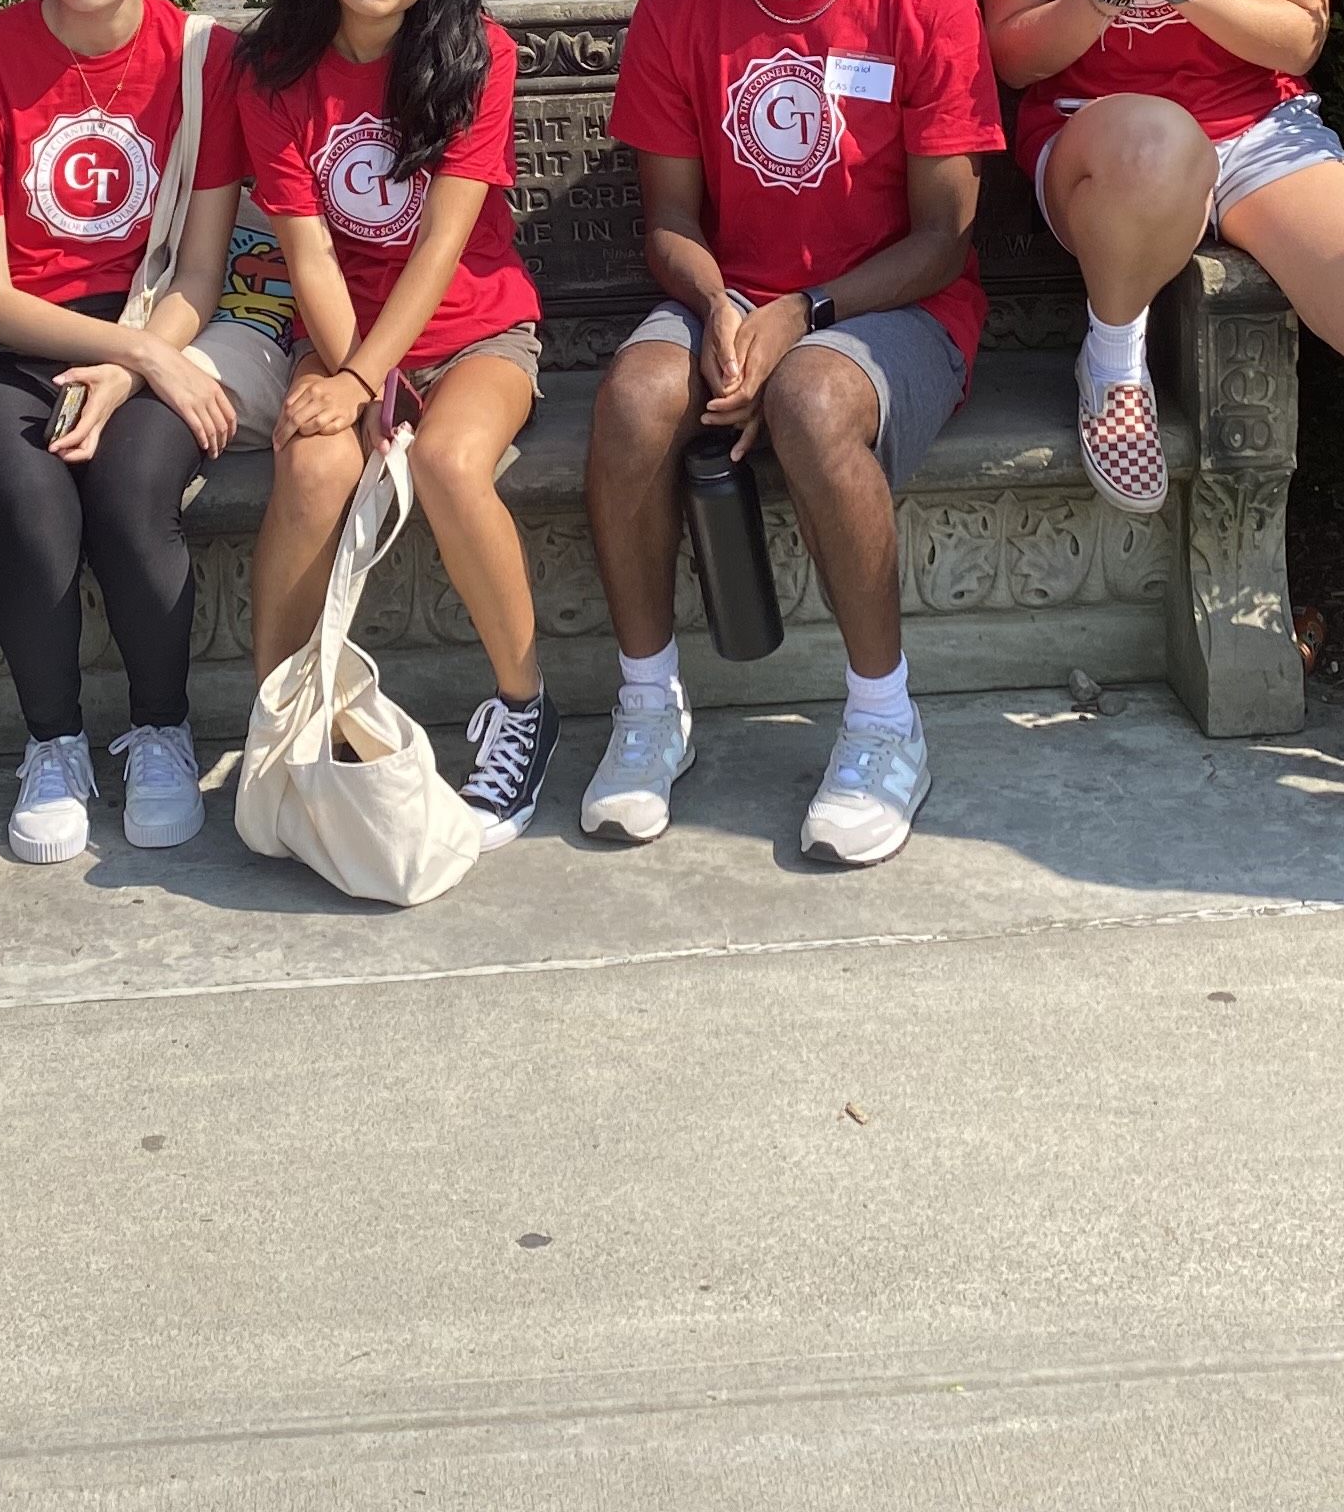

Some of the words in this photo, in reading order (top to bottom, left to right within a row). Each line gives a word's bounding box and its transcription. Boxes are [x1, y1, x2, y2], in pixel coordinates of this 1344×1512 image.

[738, 95, 754, 114] THE
[750, 65, 793, 94] CORNELL
[766, 94, 815, 145] CT
[320, 158, 332, 181] THE
[331, 130, 370, 159] CORNELL
[739, 122, 765, 163] SERVICE
[767, 161, 798, 176] WORK
[64, 152, 119, 204] CT
[344, 159, 393, 207] CT
[503, 186, 552, 213] ND
[59, 217, 90, 233] WORK
[93, 181, 145, 233] SCHOLARSHIP
[348, 222, 376, 237] WORK
[572, 220, 613, 242] IN
